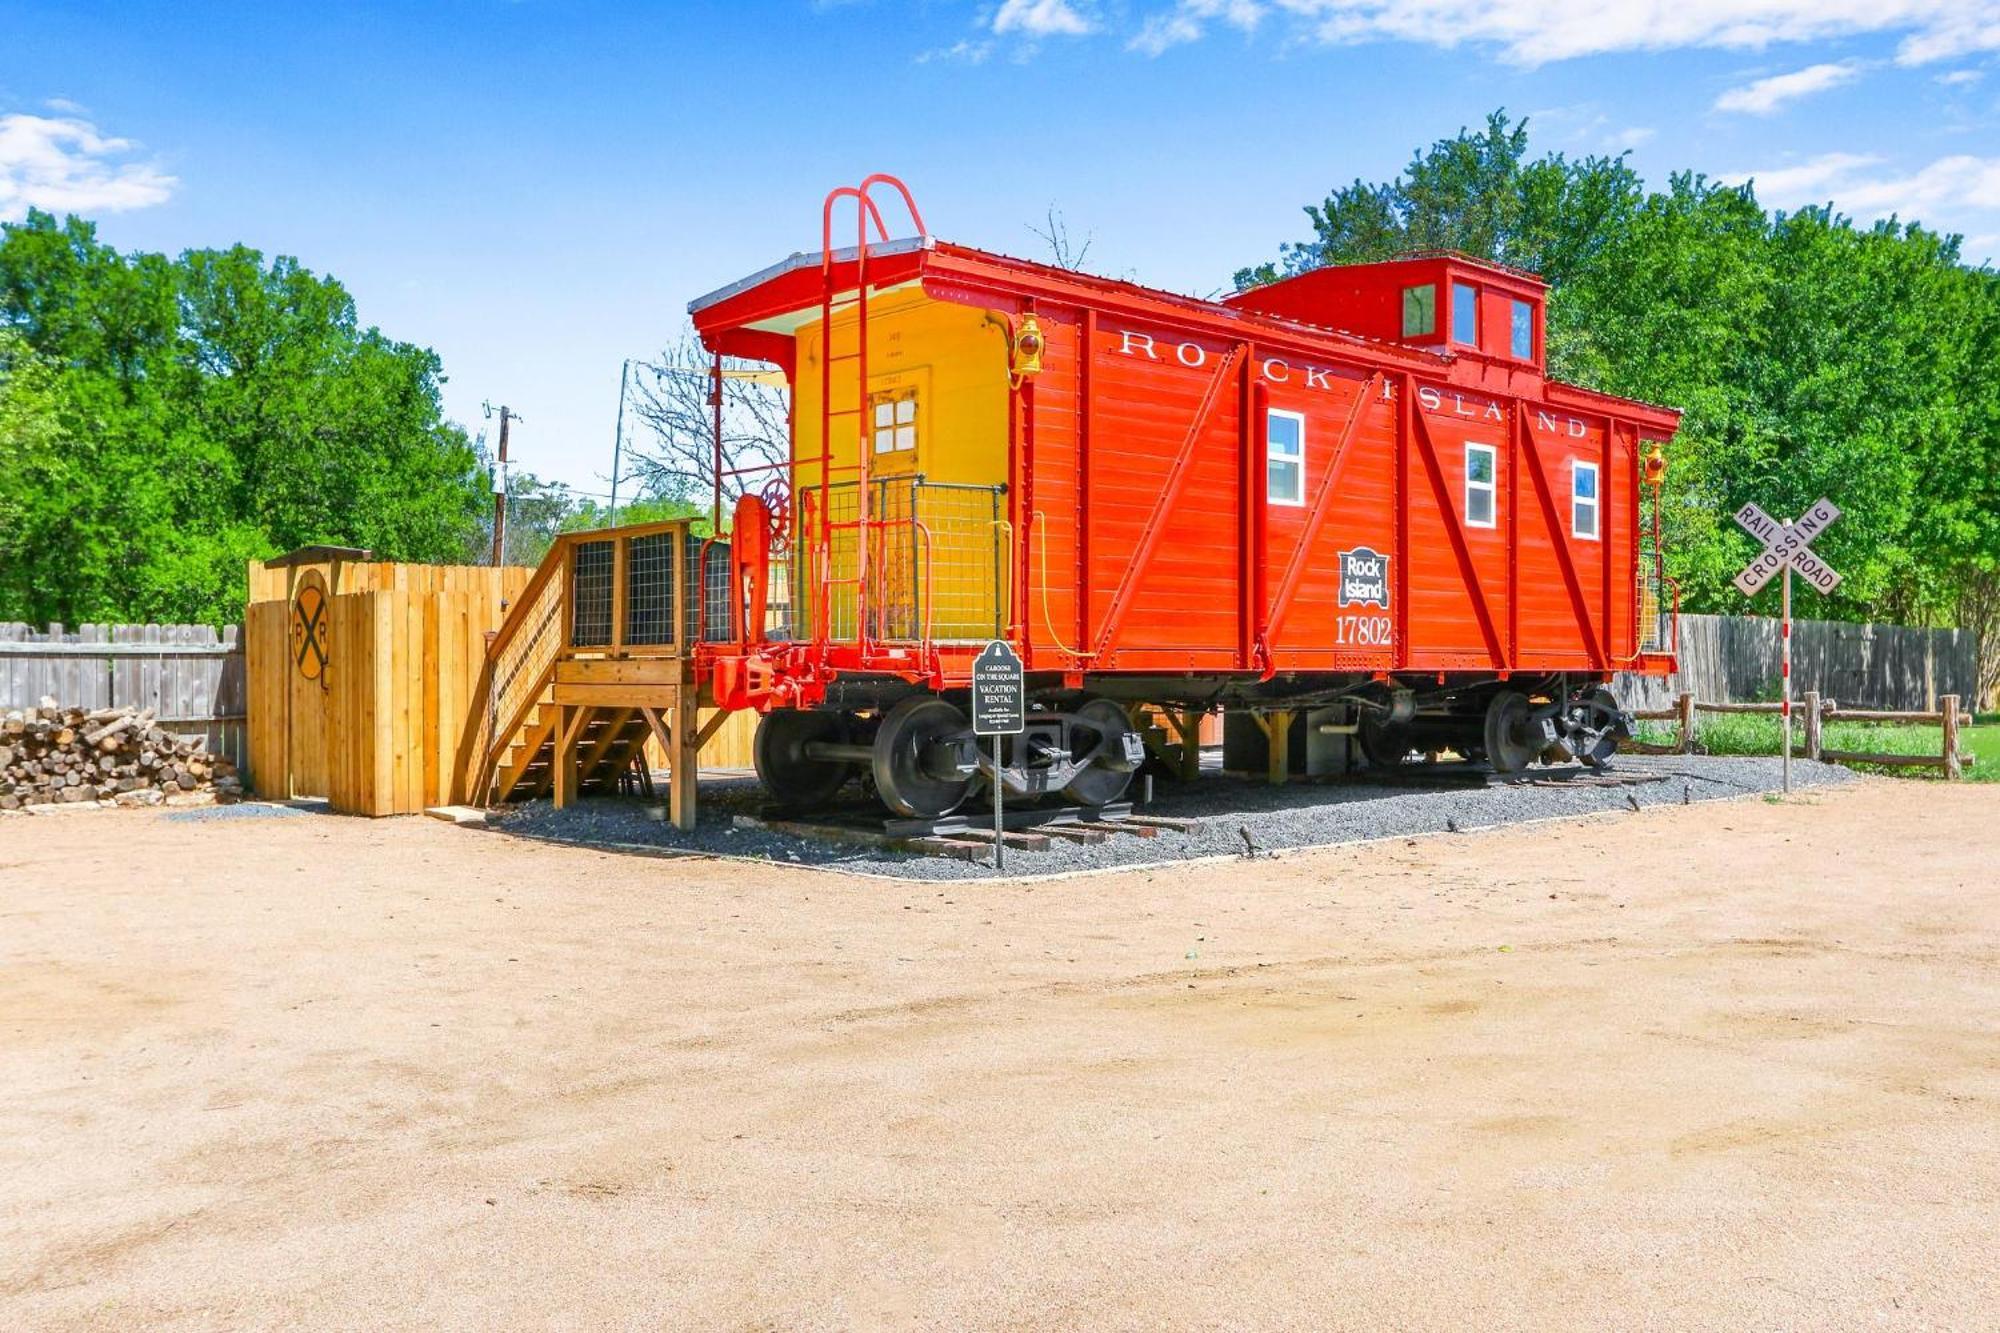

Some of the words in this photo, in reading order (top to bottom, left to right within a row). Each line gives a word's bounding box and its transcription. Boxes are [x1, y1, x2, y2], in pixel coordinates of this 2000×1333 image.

[1119, 330, 1332, 390] ROCK
[1383, 379, 1586, 438] ISLAND
[1739, 507, 1774, 542] RAIL
[1792, 552, 1833, 587] ROAD
[1743, 508, 1829, 586] CROSSING
[1347, 556, 1380, 577] Rock
[1345, 579, 1382, 599] Island
[1335, 616, 1391, 645] 17802
[979, 684, 1018, 693] VACATION
[984, 695, 1013, 703] RENTAL
